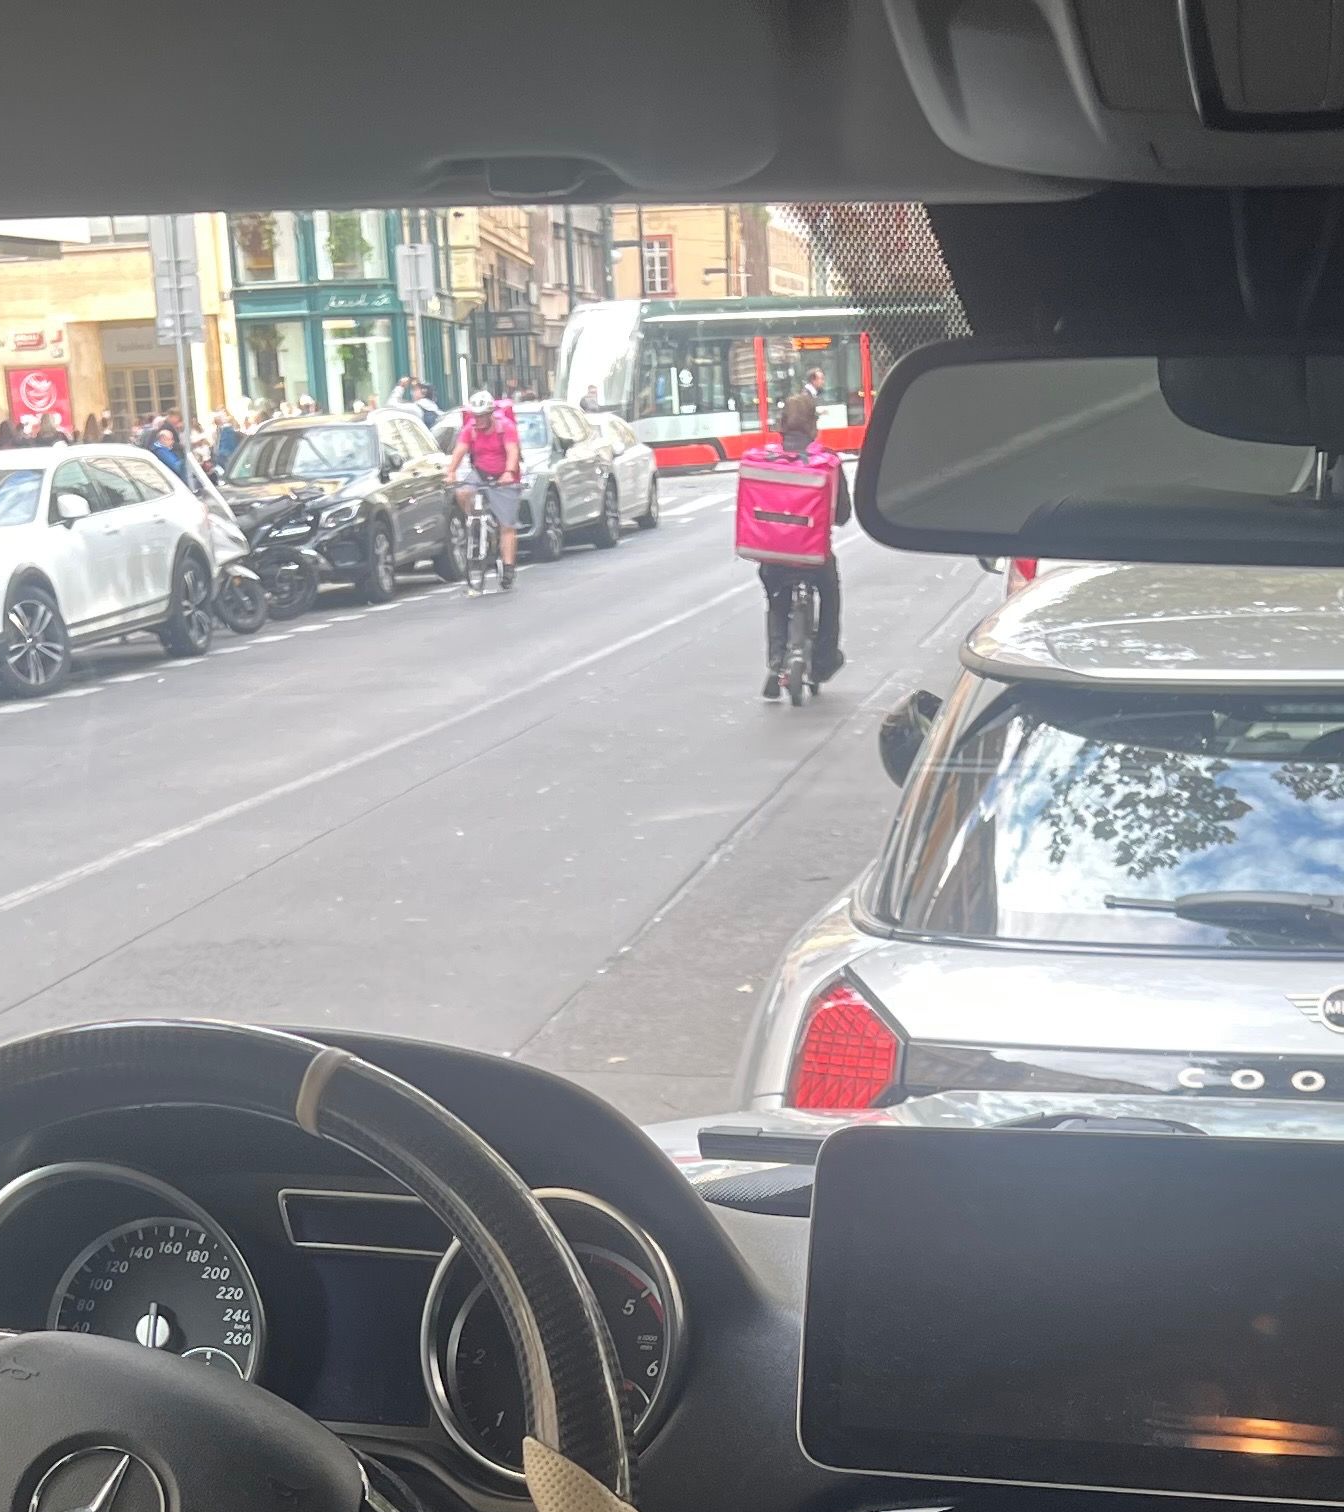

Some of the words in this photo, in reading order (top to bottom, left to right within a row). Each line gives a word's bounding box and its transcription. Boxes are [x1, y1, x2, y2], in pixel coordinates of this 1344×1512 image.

[129, 1247, 154, 1259] 140
[159, 1241, 182, 1255] 160
[186, 1250, 209, 1263] 180
[107, 1261, 129, 1273] 120
[201, 1267, 230, 1281] 200
[89, 1279, 113, 1292] 100
[216, 1287, 244, 1300] 220
[77, 1300, 95, 1312] 80
[622, 1299, 636, 1316] 5
[223, 1308, 250, 1322] 240
[71, 1321, 90, 1333] 60
[224, 1332, 252, 1346] 260
[473, 1350, 486, 1365] 2
[646, 1360, 659, 1377] 6
[496, 1411, 504, 1426] 1
